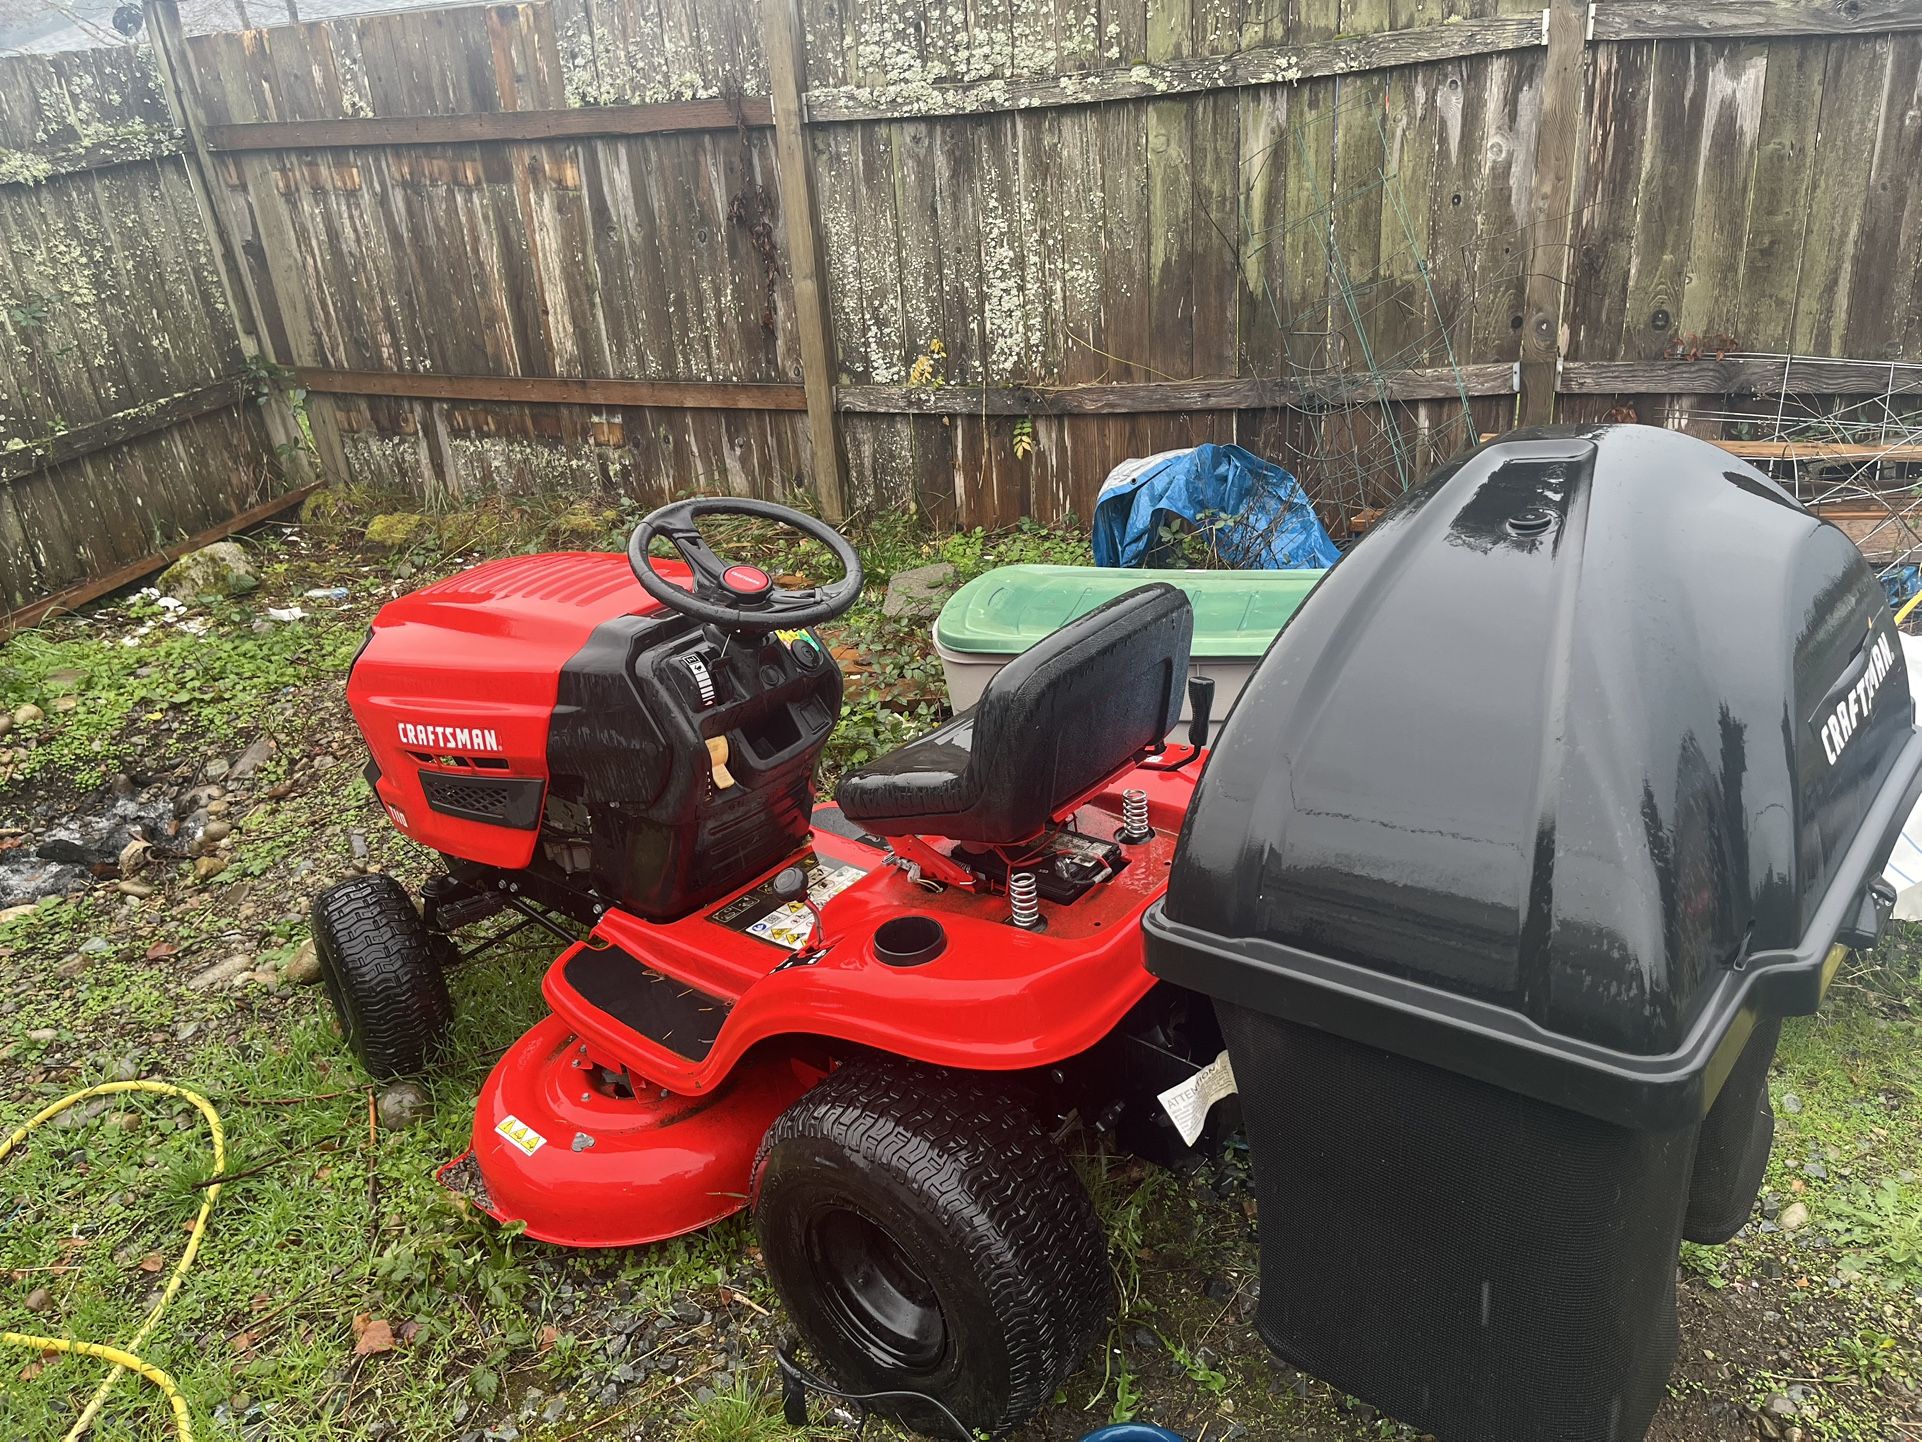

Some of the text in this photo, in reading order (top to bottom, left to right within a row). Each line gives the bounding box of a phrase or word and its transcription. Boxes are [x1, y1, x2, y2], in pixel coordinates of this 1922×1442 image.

[1821, 632, 1893, 766] CRAFTMAN
[398, 722, 498, 751] CRAFTSMAN
[1167, 1066, 1216, 1109] ATTENTION
